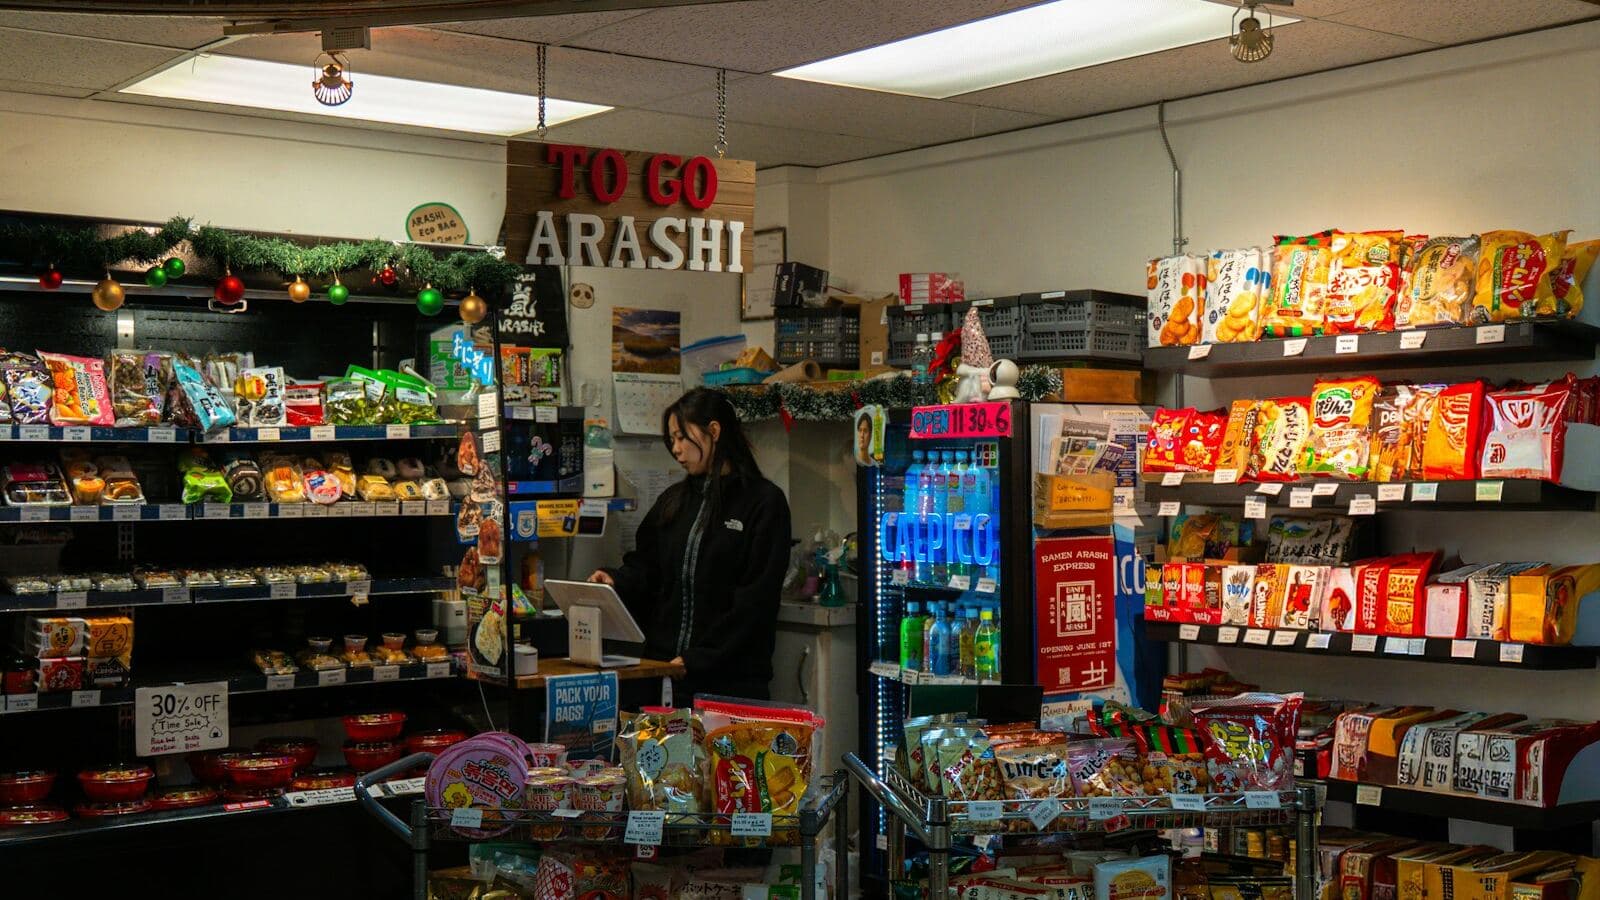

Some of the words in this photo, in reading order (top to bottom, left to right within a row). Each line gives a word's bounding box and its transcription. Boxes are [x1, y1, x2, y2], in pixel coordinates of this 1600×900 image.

[546, 143, 629, 204] TO
[647, 152, 719, 210] GO
[412, 211, 446, 227] ARASHI
[419, 226, 435, 236] ECO
[438, 219, 456, 231] BAG
[525, 210, 746, 273] ARASHI
[913, 409, 949, 435] OPEN
[952, 408, 963, 433] 11
[969, 408, 986, 432] 30
[995, 404, 1009, 433] 6
[880, 512, 993, 566] CALPICO
[1041, 551, 1073, 563] RAMEN
[1076, 550, 1109, 560] ARASHI
[1053, 562, 1096, 572] EXPRESS
[1254, 581, 1270, 628] CRUNKY
[1040, 644, 1074, 654] OPENING
[1076, 642, 1097, 651] JUNE
[555, 686, 581, 706] PACK
[583, 684, 610, 702] YOUR
[151, 694, 190, 716] 30%
[195, 694, 220, 712] OFF
[555, 704, 585, 723] BAGS!
[158, 720, 180, 730] Time
[185, 719, 201, 728] Sale
[682, 882, 742, 896] ホットケーキ
